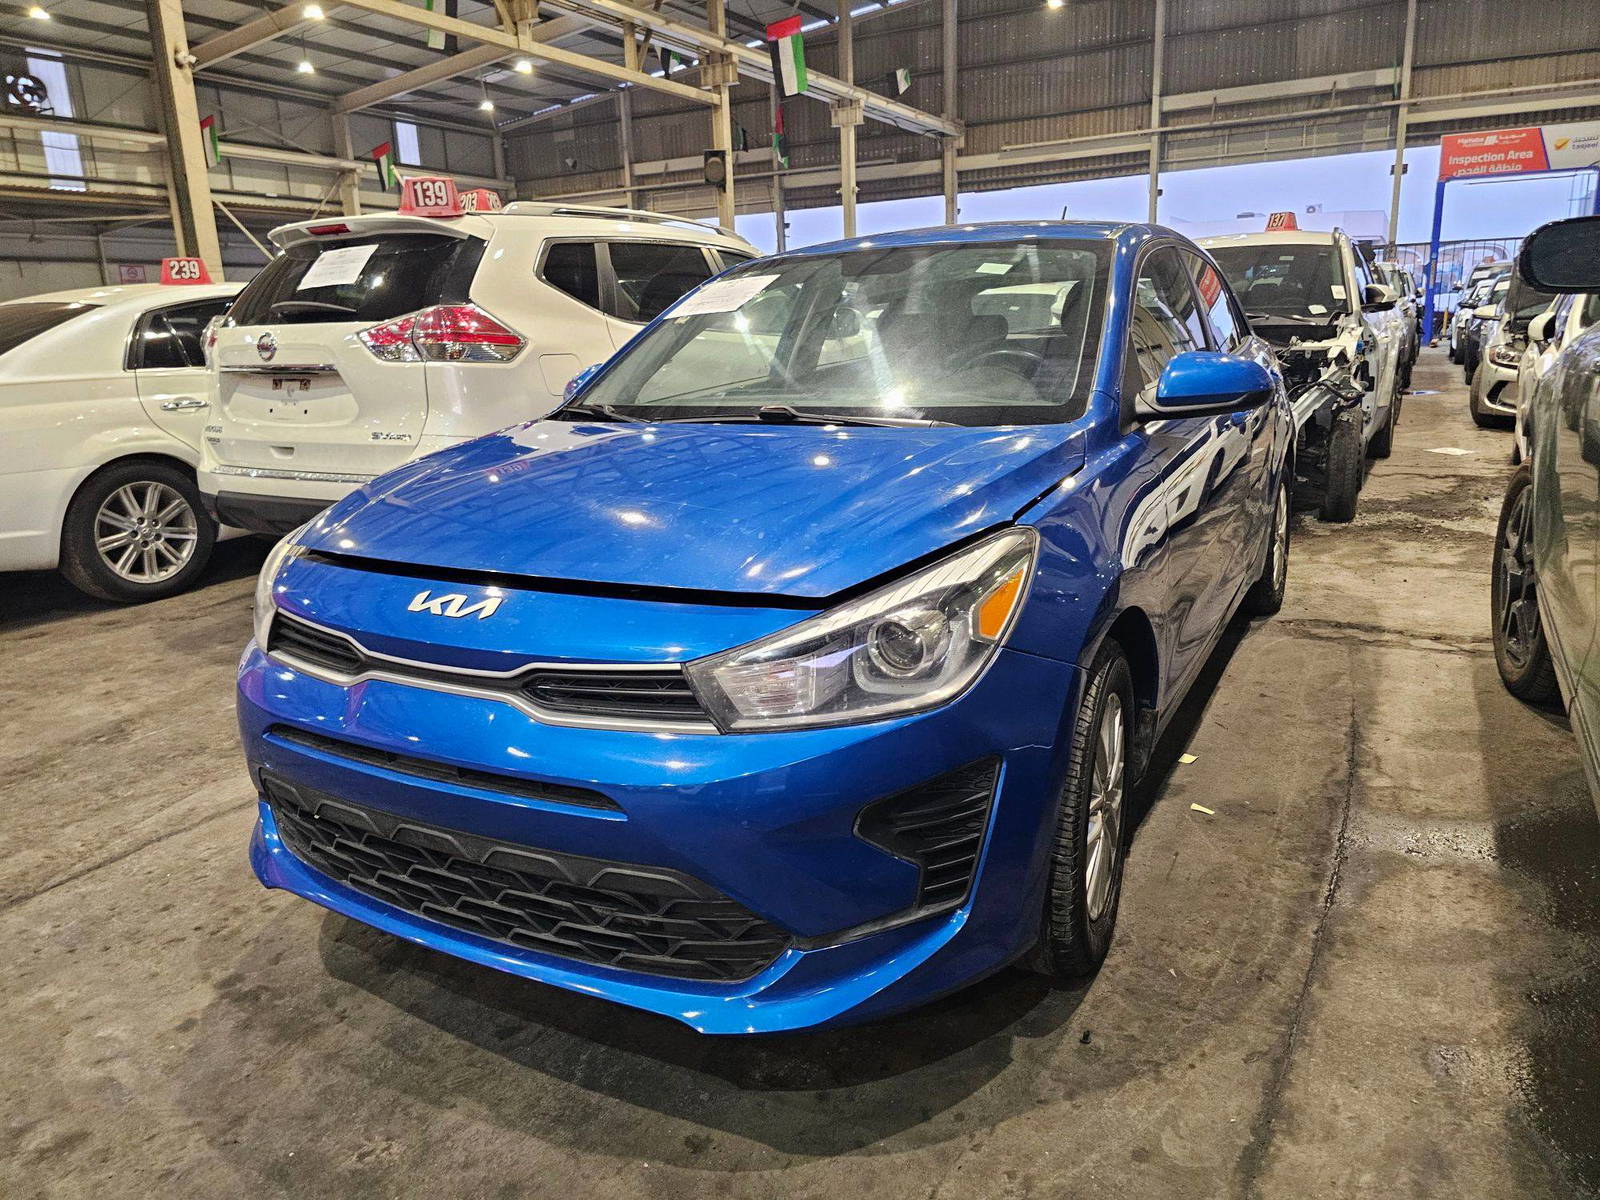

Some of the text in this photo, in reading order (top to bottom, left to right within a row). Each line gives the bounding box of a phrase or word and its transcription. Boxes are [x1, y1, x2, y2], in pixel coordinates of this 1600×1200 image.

[1448, 150, 1534, 166] Inspection Area
[414, 181, 448, 207] 139
[460, 192, 478, 211] 203
[1269, 213, 1286, 227] 137
[169, 260, 200, 279] 239
[407, 590, 503, 620] KIA
